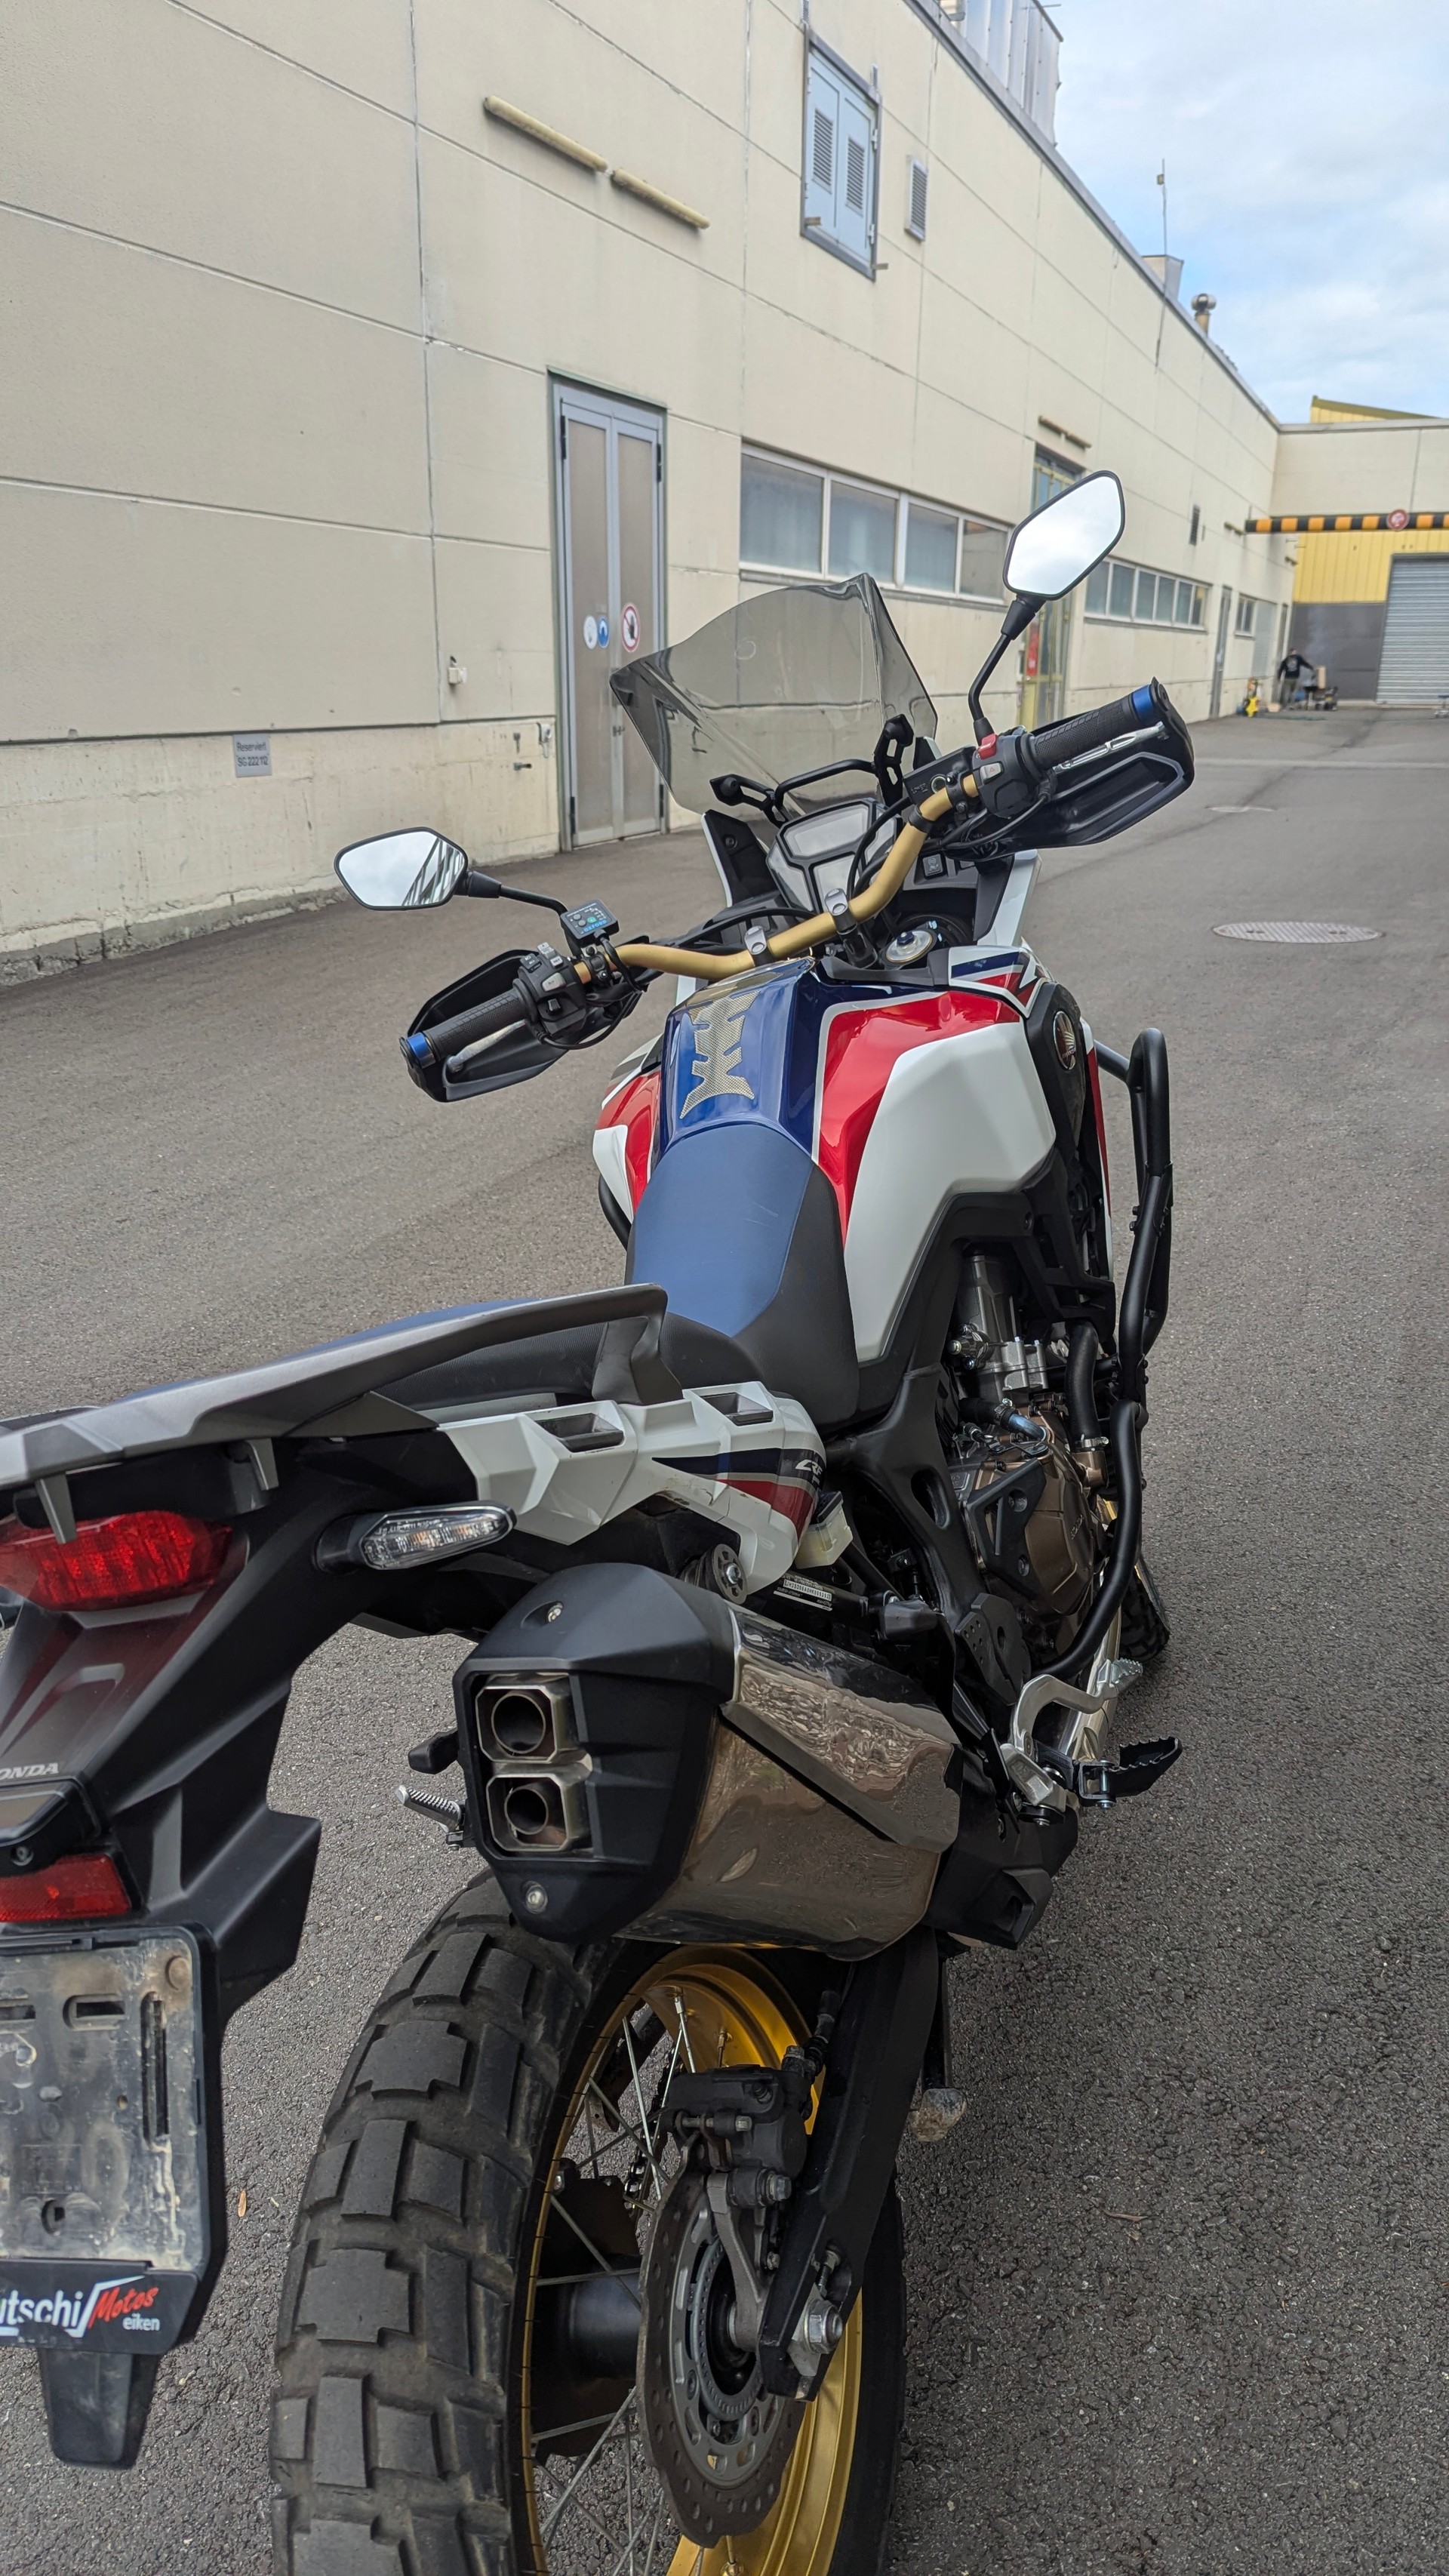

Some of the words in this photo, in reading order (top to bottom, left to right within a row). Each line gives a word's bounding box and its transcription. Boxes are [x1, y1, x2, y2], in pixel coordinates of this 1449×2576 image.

[795, 1459, 823, 1476] CRF
[88, 2286, 160, 2329] Motos
[122, 2313, 160, 2331] eiken
